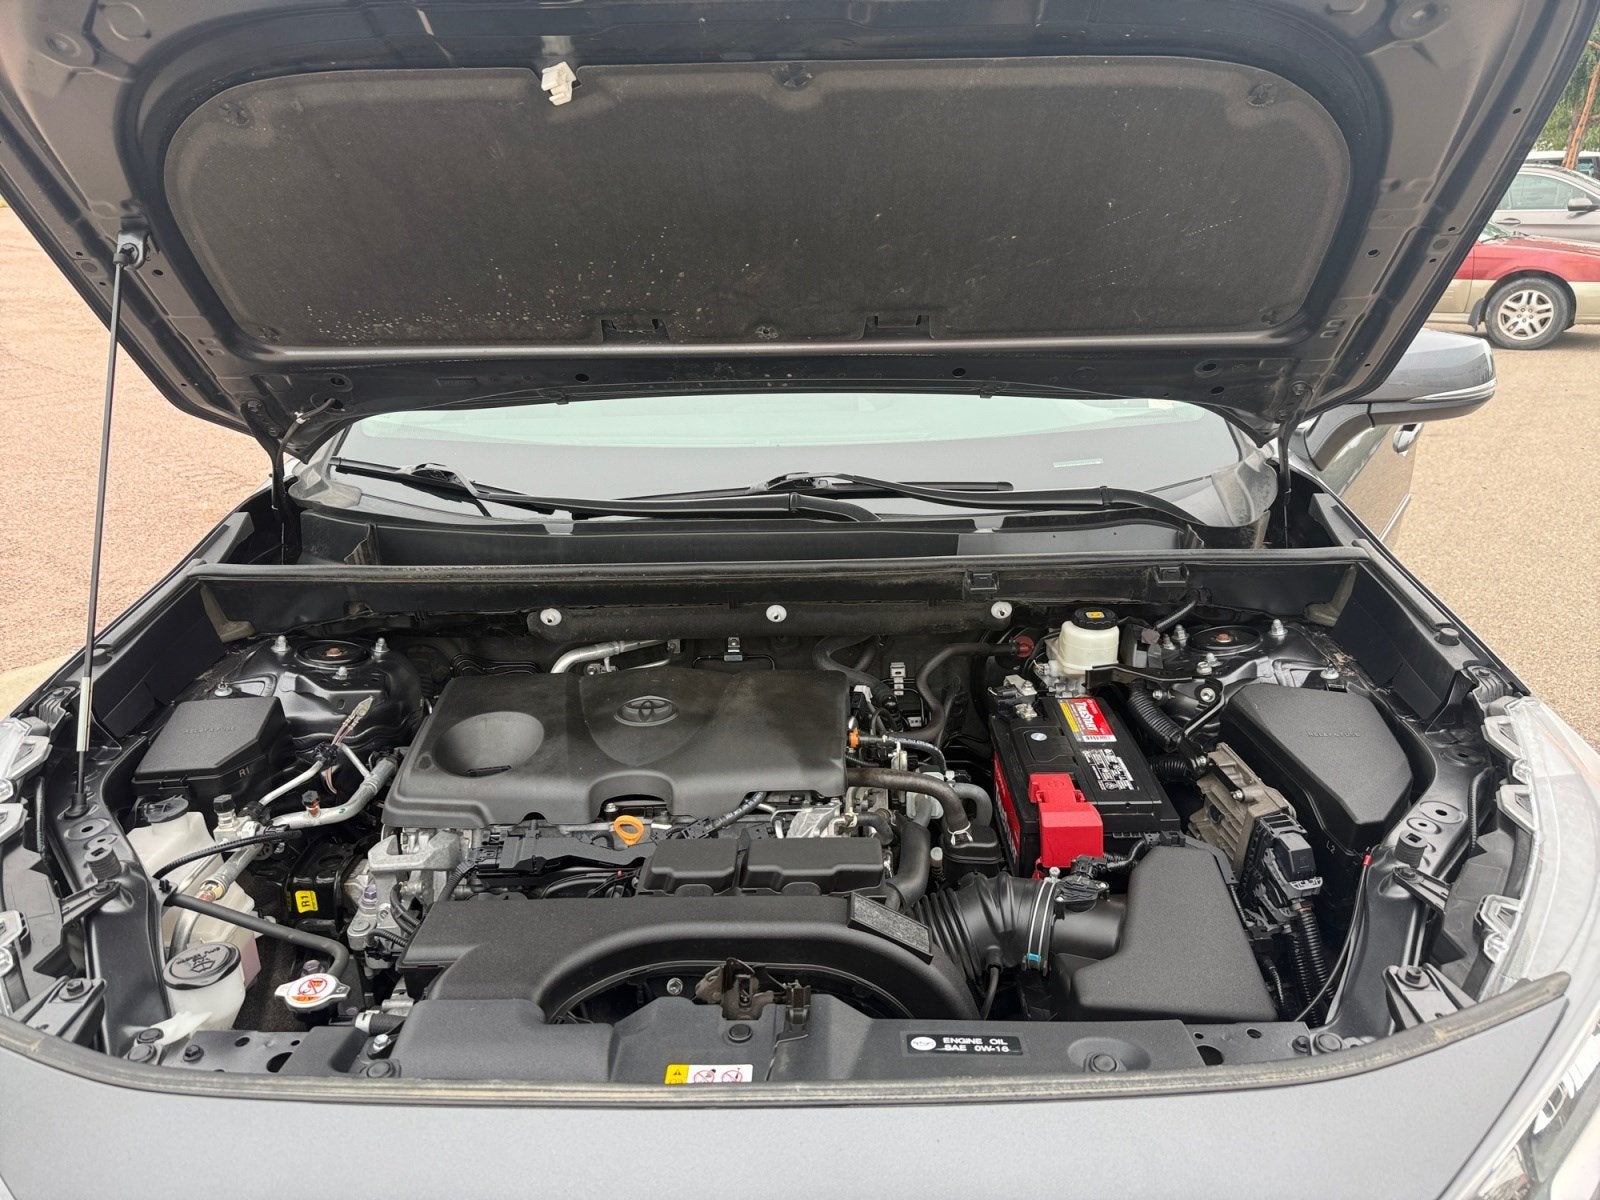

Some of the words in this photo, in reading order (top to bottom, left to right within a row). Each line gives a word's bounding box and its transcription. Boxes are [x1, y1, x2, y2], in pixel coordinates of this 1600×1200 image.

[238, 766, 250, 778] R1
[300, 895, 310, 908] R1
[942, 1036, 983, 1045] ENGINE
[989, 1038, 1008, 1046] OIL
[944, 1044, 967, 1052] SAE
[974, 1045, 1009, 1053] 0W-16
